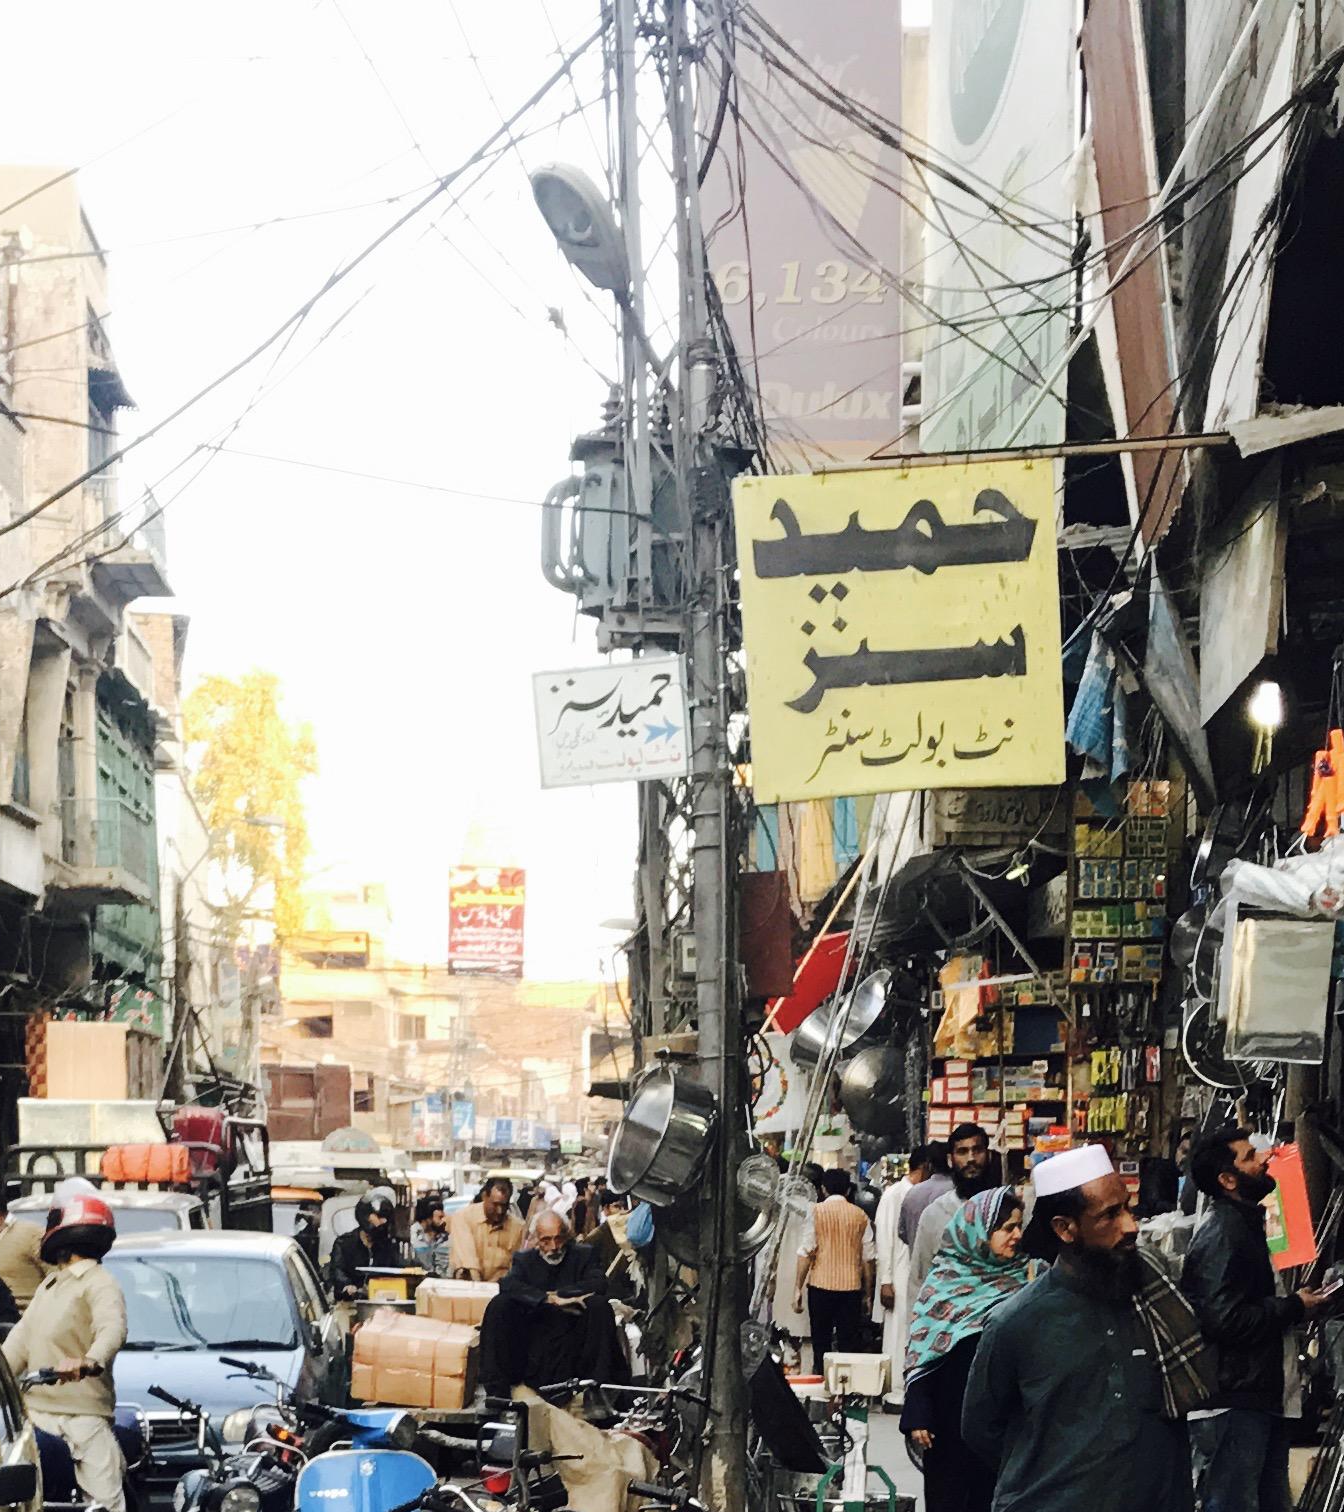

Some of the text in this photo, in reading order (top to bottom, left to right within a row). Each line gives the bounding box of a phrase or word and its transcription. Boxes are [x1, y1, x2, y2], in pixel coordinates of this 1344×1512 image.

[714, 260, 888, 312] 6,134
[762, 380, 896, 420] Dulux
[753, 488, 1039, 604] حمید
[783, 616, 1027, 714] سنز
[597, 673, 672, 739] حمید
[860, 710, 947, 769] بولٹ
[308, 1488, 349, 1500] vespa
